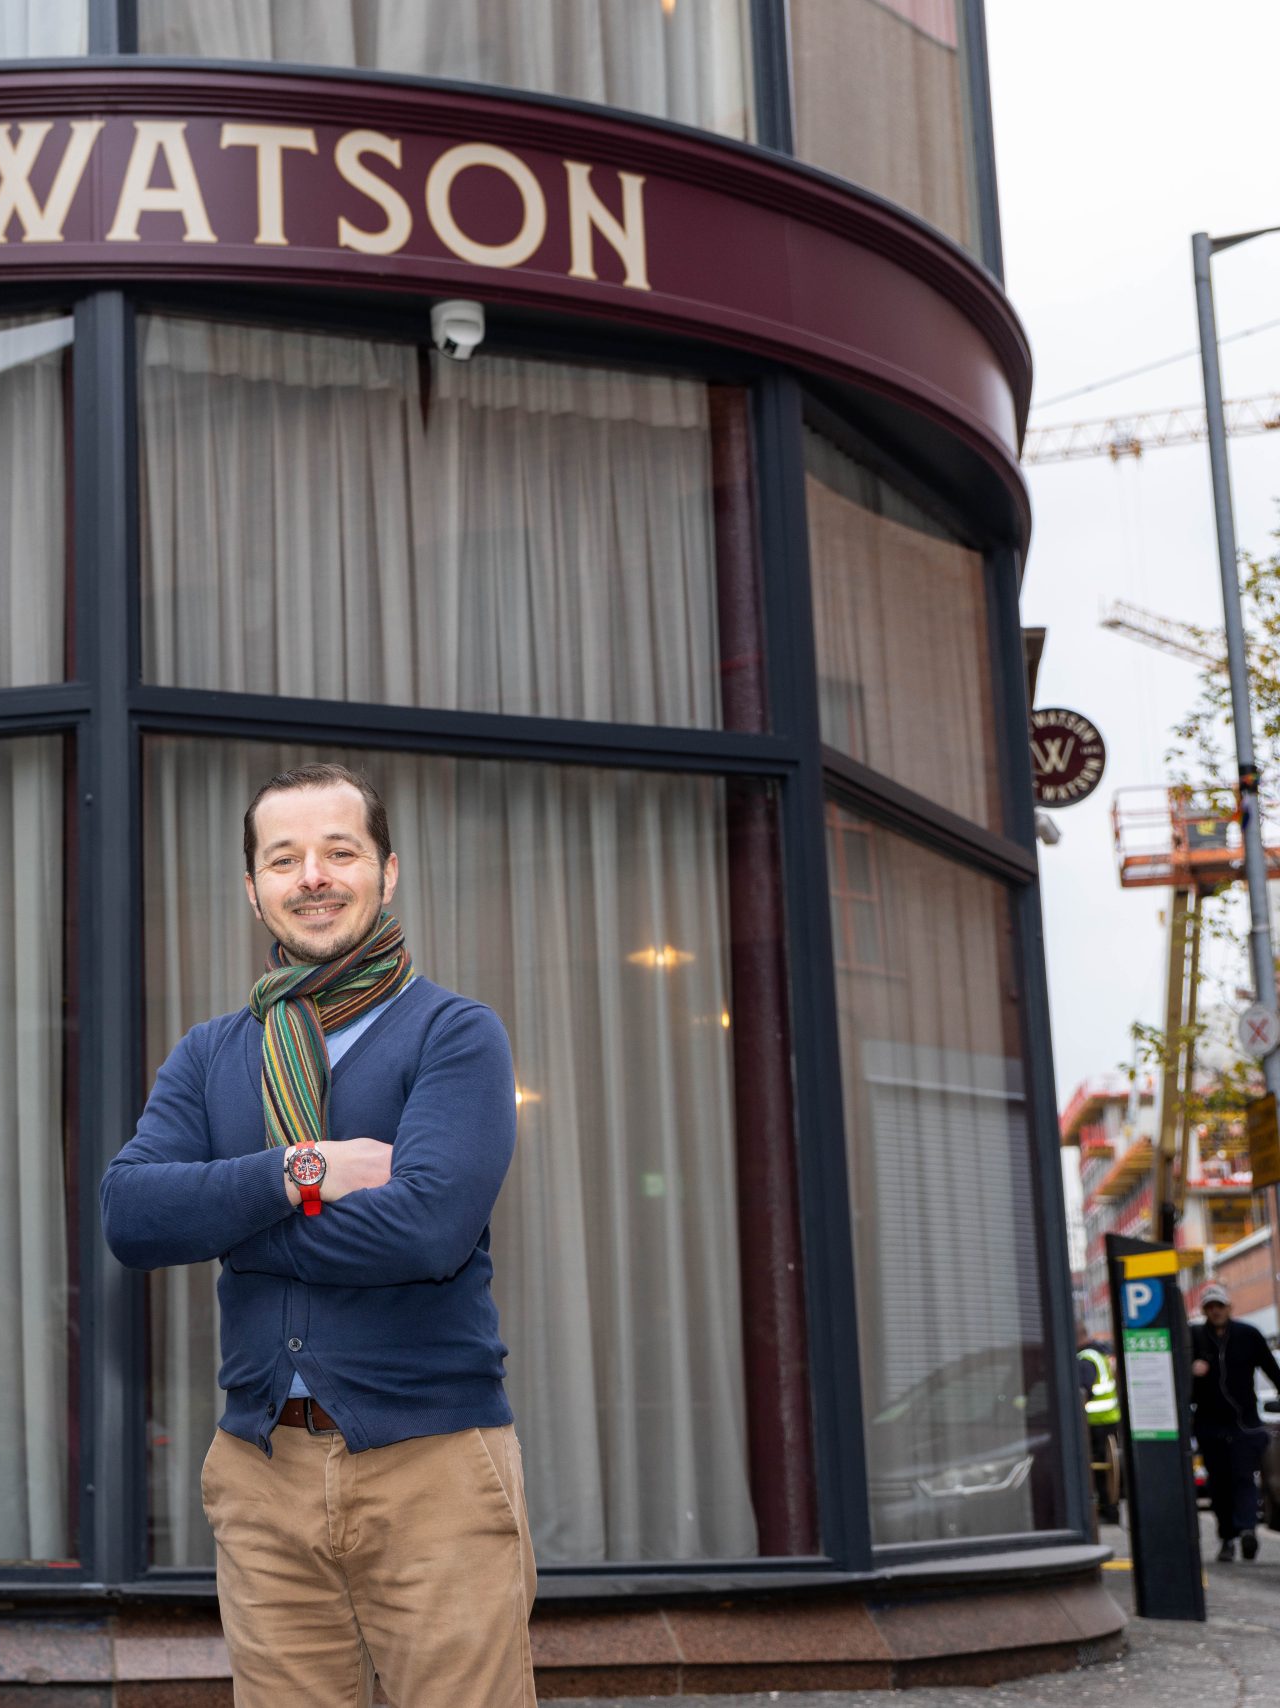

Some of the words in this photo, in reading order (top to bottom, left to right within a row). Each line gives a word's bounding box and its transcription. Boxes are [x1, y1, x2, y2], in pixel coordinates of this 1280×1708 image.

[1030, 709, 1098, 743] WATSON
[1029, 736, 1075, 774] W
[1125, 1282, 1153, 1319] P
